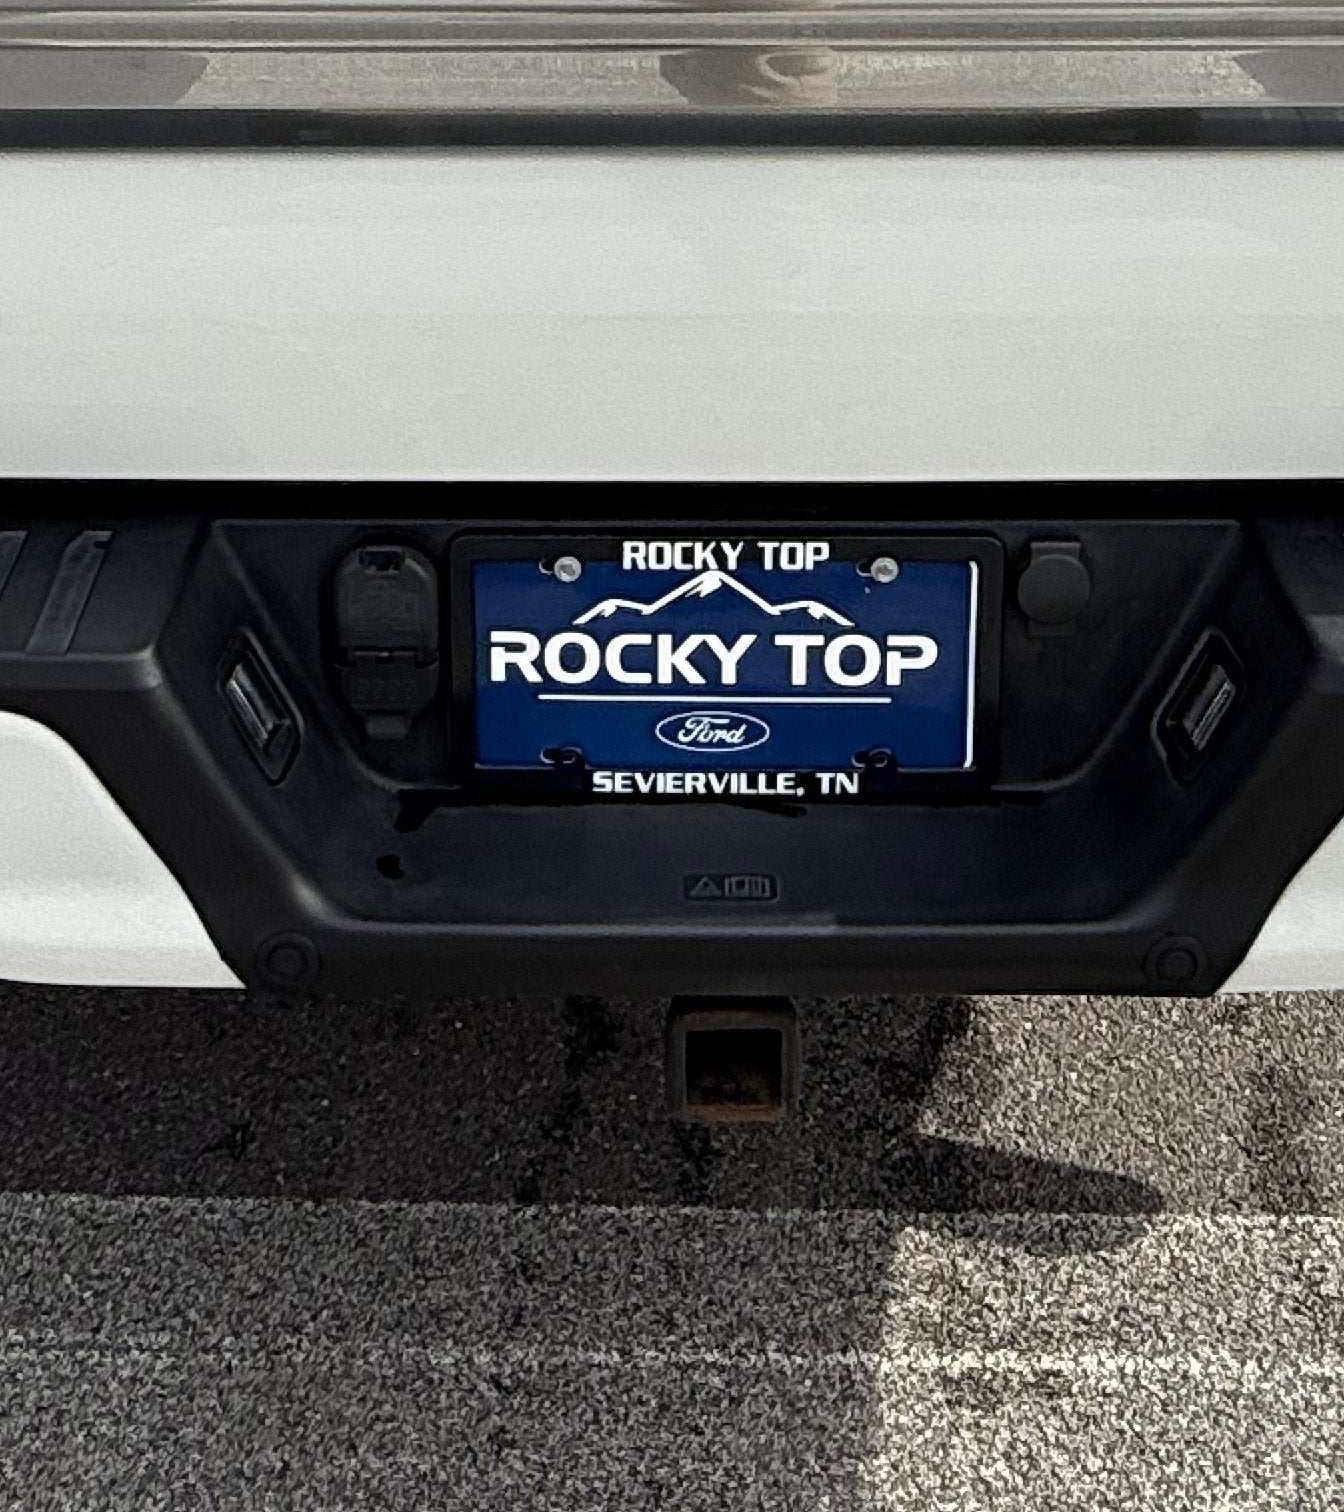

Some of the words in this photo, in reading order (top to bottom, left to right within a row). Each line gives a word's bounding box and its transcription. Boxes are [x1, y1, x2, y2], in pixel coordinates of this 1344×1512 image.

[623, 541, 743, 572] ROCKY
[757, 541, 829, 571] TOP
[490, 630, 757, 685] ROCKY
[775, 634, 937, 686] TOP
[677, 716, 747, 744] Ford
[592, 771, 805, 796] SEVIERVILLE,
[815, 772, 859, 795] TN
